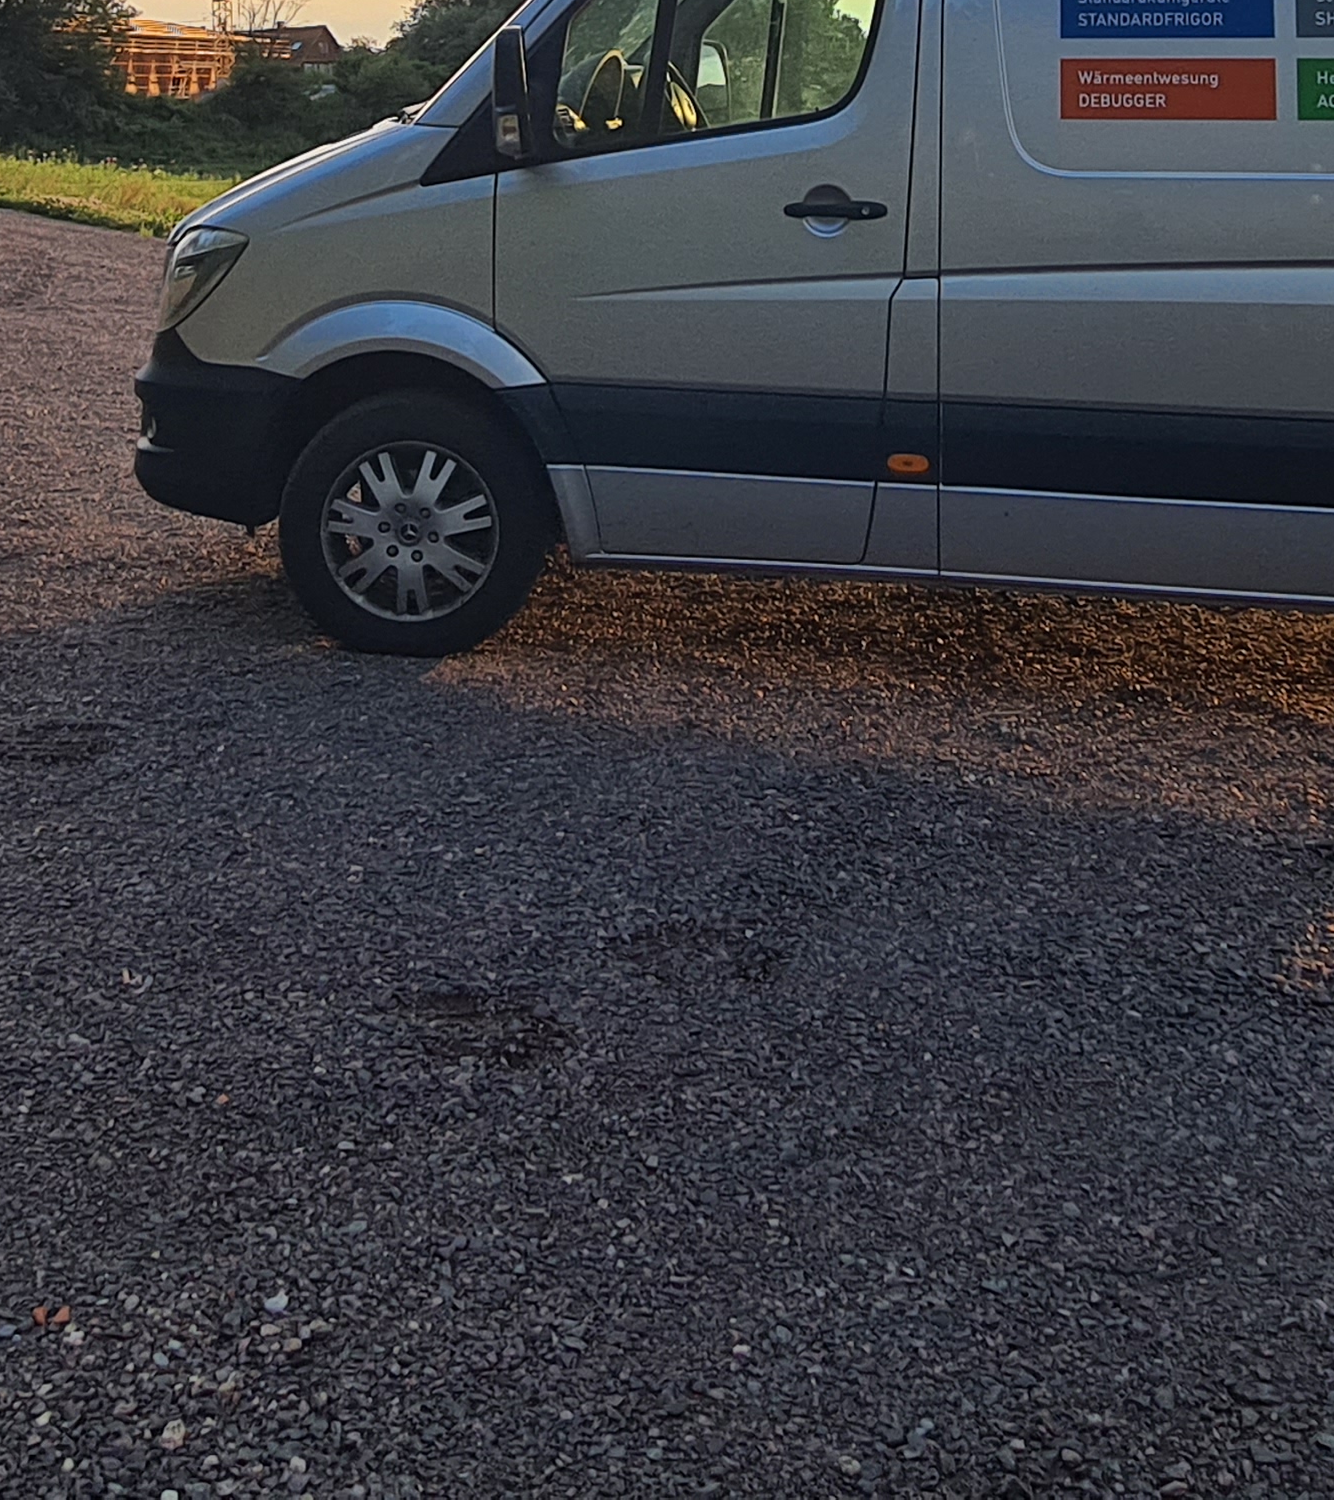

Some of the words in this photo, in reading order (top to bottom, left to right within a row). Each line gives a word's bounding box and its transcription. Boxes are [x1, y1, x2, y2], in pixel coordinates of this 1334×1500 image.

[1077, 11, 1224, 27] STANDARDFRIGOR
[1077, 70, 1219, 89] Wärmeentwesung
[1078, 93, 1166, 108] DEBUGGER
